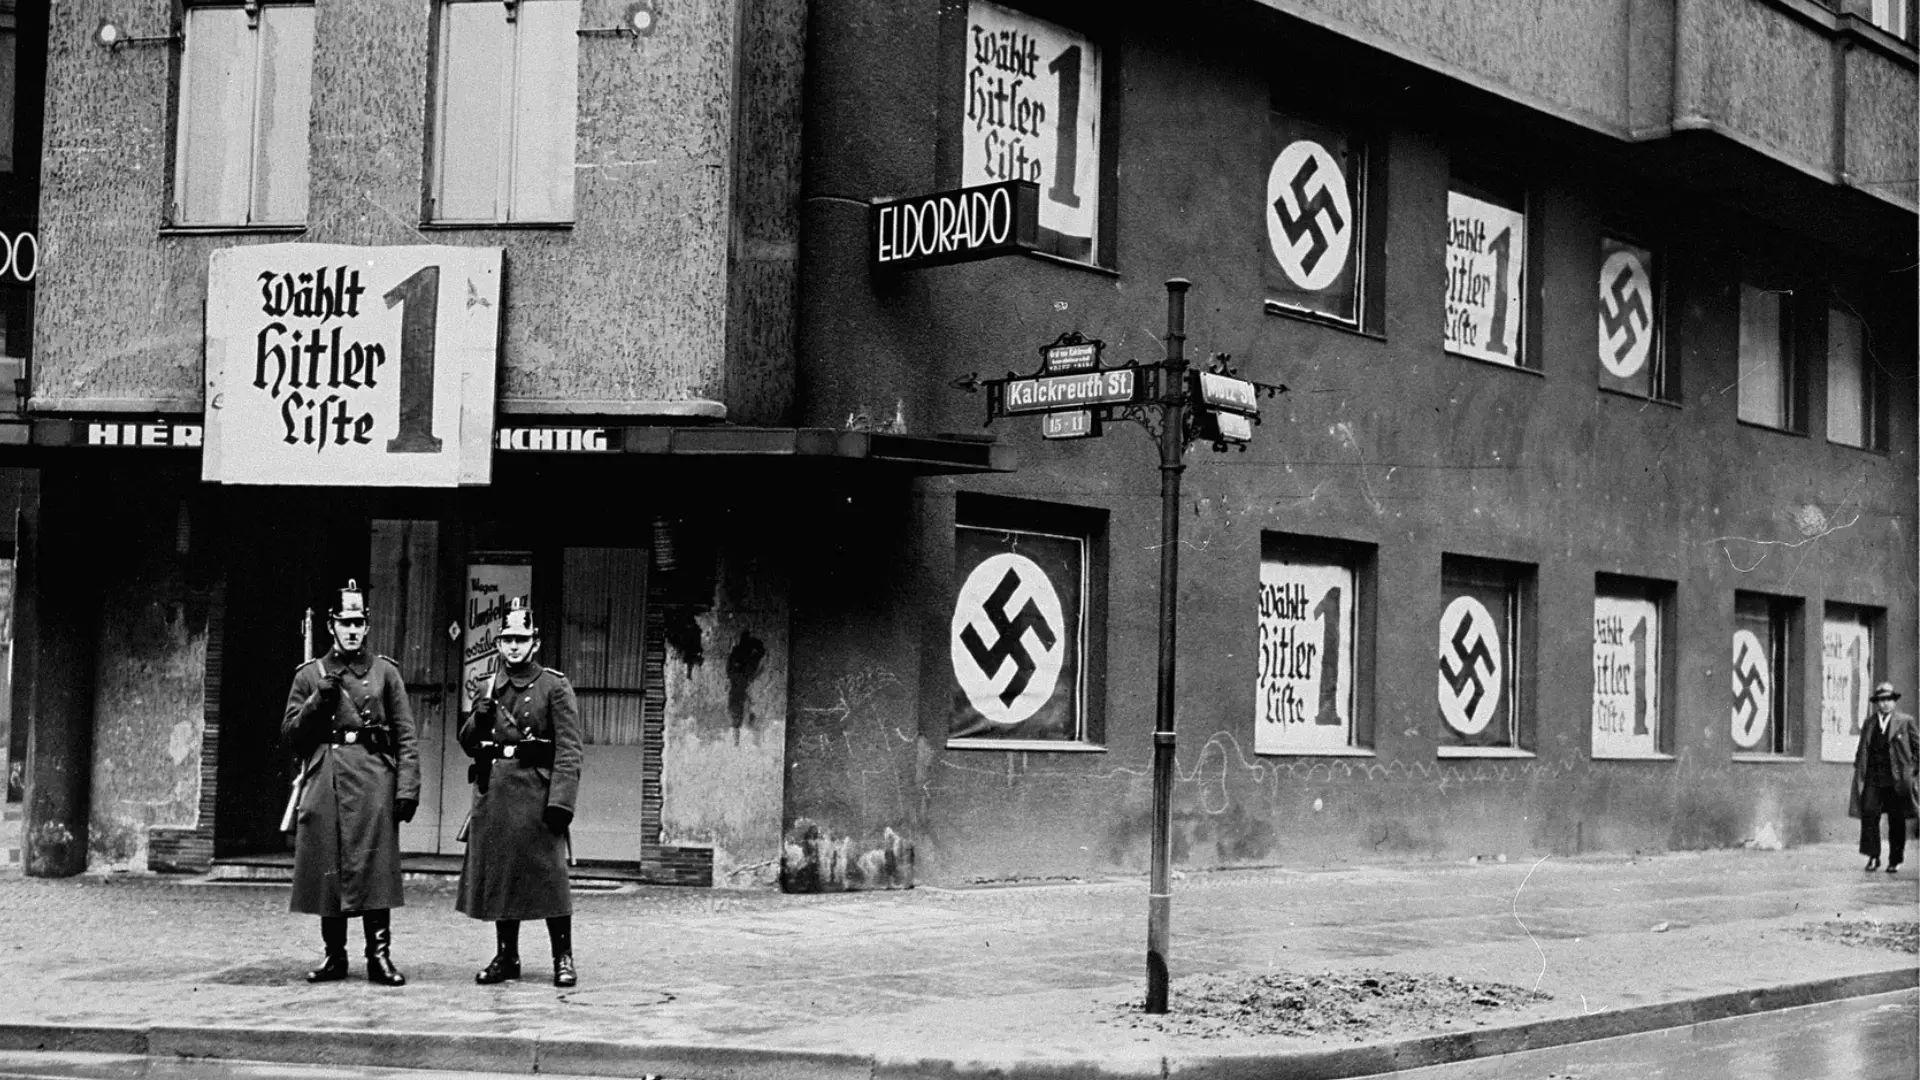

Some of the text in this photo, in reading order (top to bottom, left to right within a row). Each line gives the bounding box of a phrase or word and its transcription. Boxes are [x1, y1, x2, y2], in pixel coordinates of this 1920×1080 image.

[970, 24, 1040, 80] Wählt
[967, 65, 1046, 138] Hitler
[1048, 44, 1082, 209] 1
[878, 187, 1011, 262] ELDORADO
[257, 265, 366, 324] Wählt
[1445, 254, 1491, 309] itler
[1486, 226, 1511, 355] 1
[252, 321, 386, 399] Hitler
[382, 265, 443, 453] 1
[1010, 372, 1132, 406] Kalckreuth St.
[88, 424, 203, 447] HIER
[495, 428, 607, 451] ICHTIG
[1049, 418, 1062, 433] 15
[1071, 416, 1083, 431] 11
[1314, 586, 1342, 726] 1
[1596, 651, 1631, 695] itler
[1629, 615, 1649, 735] 1
